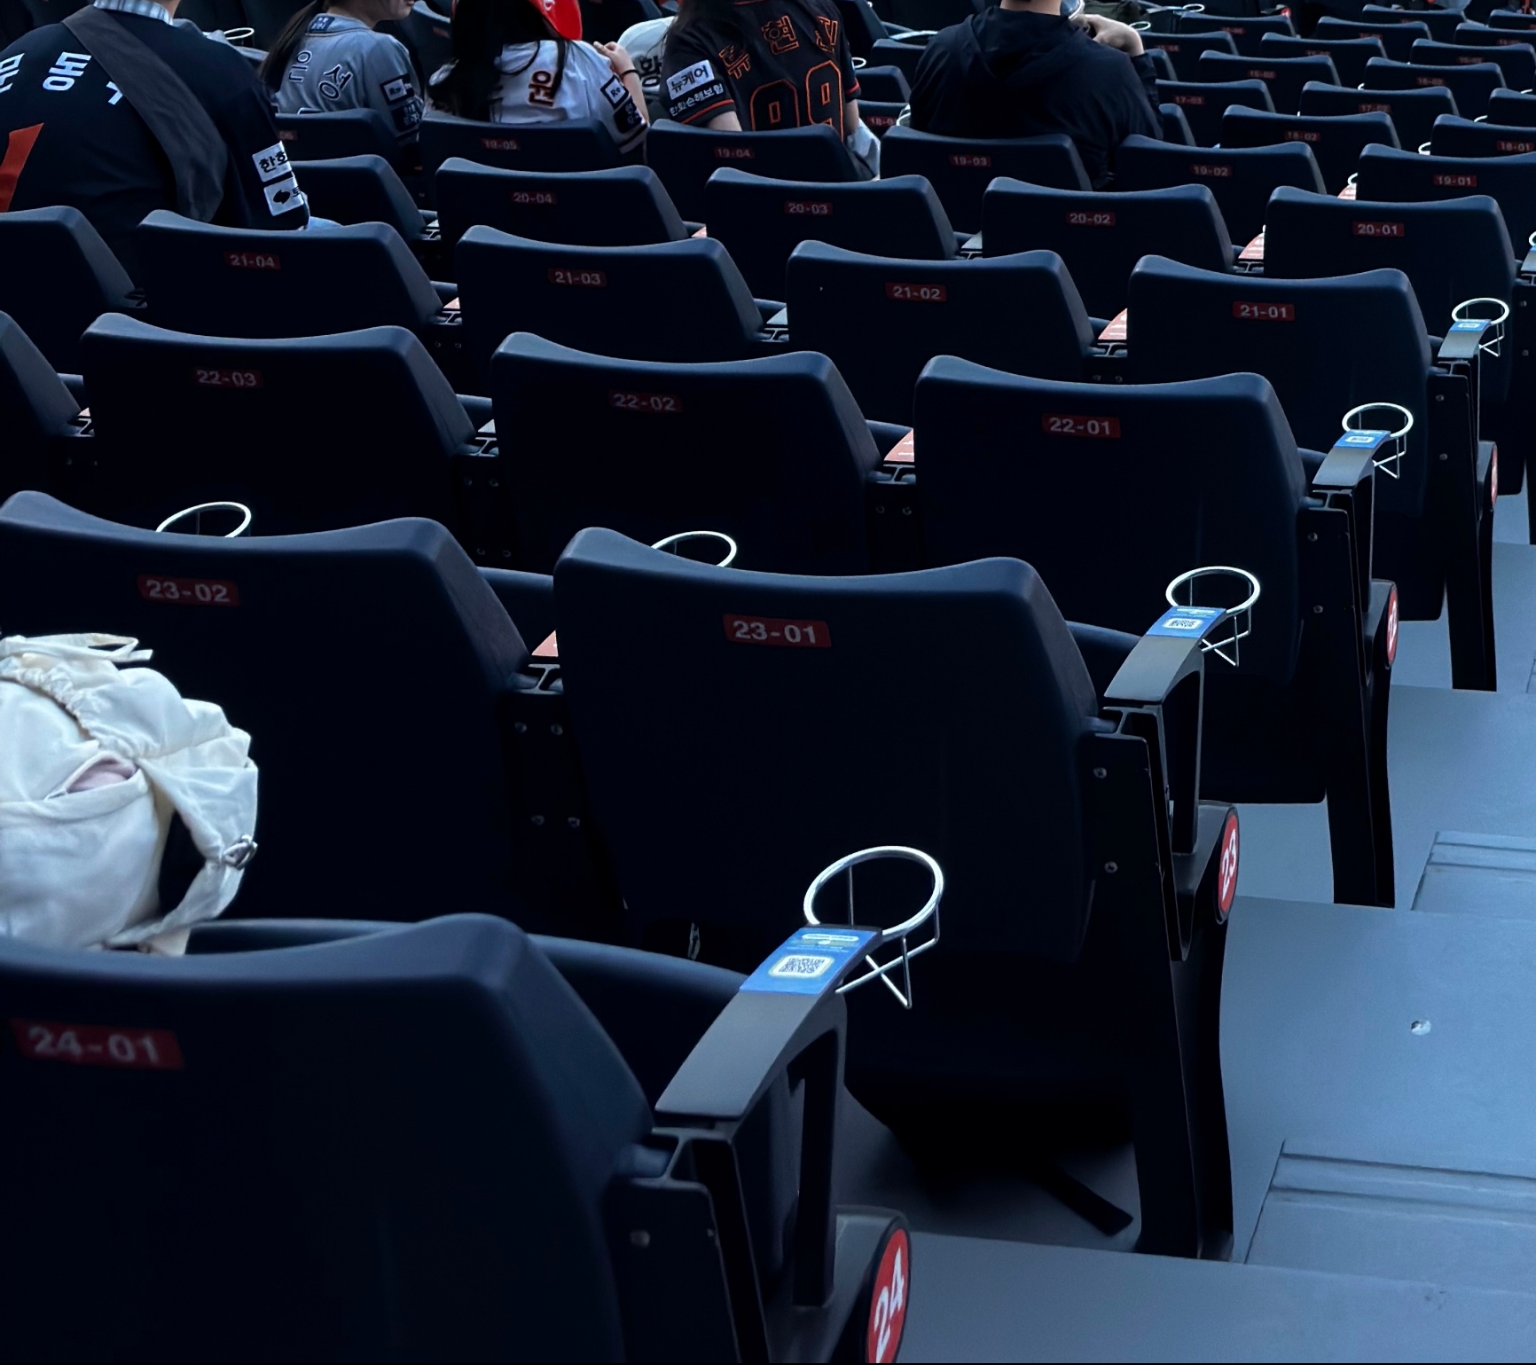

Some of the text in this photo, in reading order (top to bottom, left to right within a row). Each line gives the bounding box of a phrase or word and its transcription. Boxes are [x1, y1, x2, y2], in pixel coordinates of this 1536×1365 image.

[669, 65, 710, 95] 뉴케어
[715, 147, 752, 159] 19-04
[953, 155, 989, 167] 19-03
[1436, 175, 1473, 187] 19-01
[513, 192, 552, 204] 20-04
[788, 203, 829, 216] 20-03
[1070, 212, 1111, 226] 20-02
[1357, 223, 1399, 236] 20-01
[230, 253, 275, 268] 21-04
[555, 271, 601, 285] 21-03
[893, 286, 941, 301] 21-02
[1239, 303, 1288, 320] 21-01
[198, 370, 257, 387] 22-03
[613, 393, 677, 413] 22-02
[1048, 416, 1112, 437] 22-01
[146, 579, 231, 605] 23-02
[733, 618, 818, 645] 23-01
[1218, 827, 1237, 899] 23
[27, 1026, 160, 1065] 24-01
[872, 1246, 905, 1365] 24
